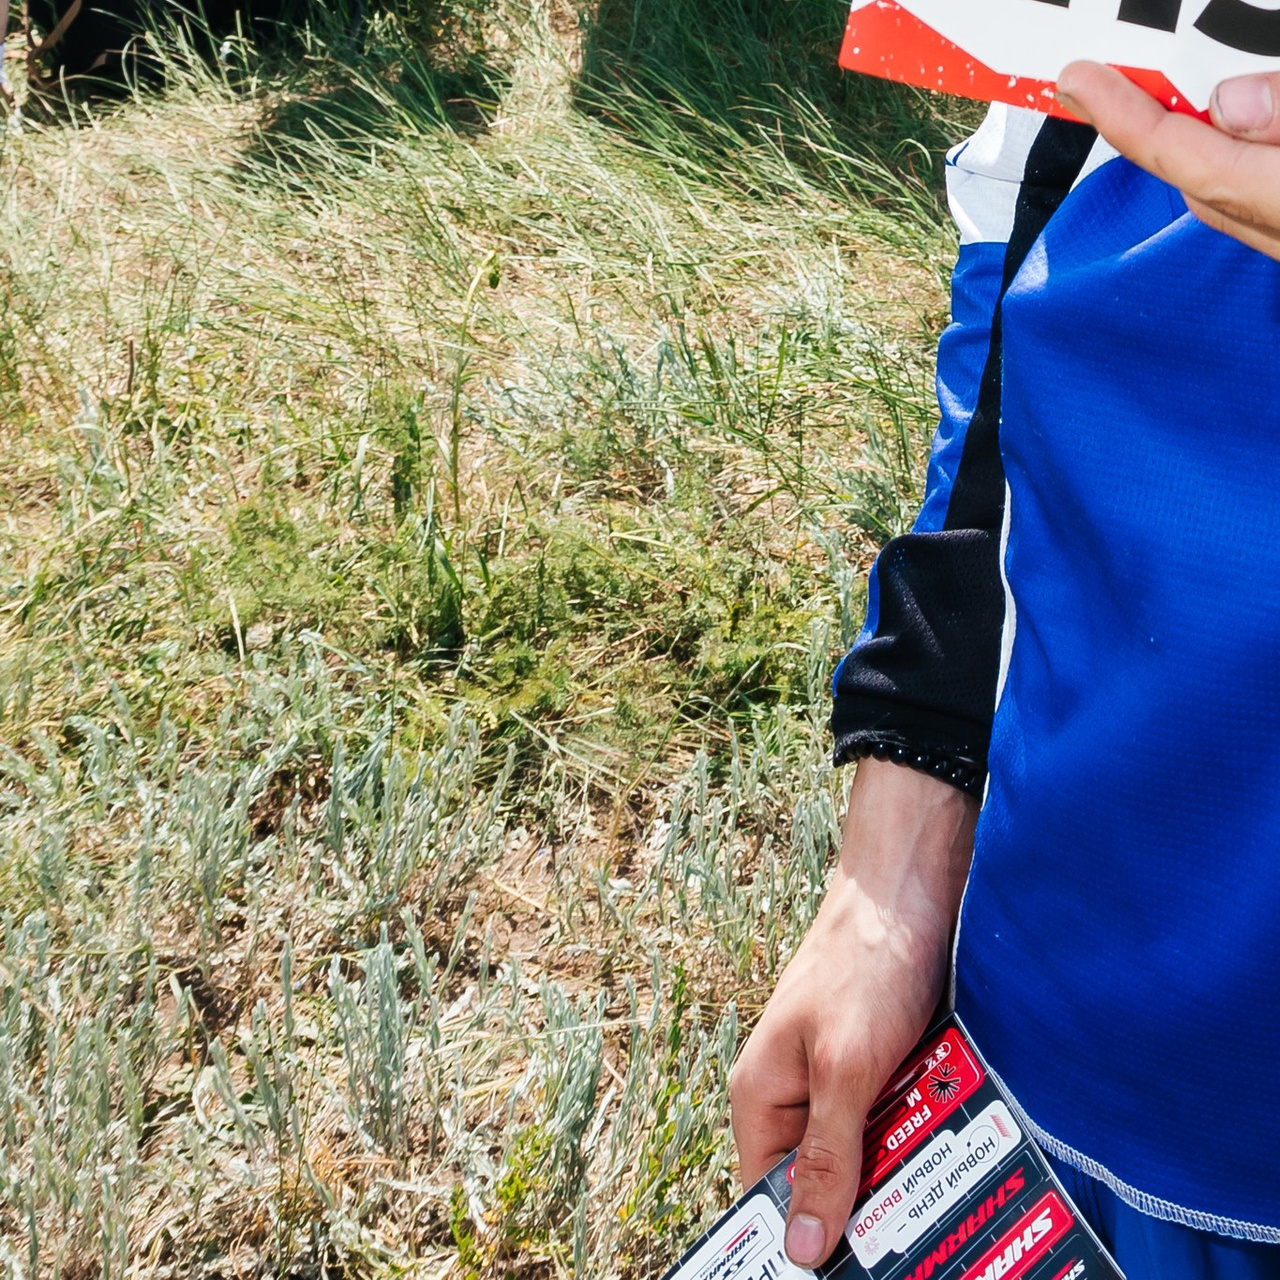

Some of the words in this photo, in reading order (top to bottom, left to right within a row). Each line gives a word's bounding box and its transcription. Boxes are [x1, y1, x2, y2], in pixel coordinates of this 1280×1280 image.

[902, 1142, 953, 1195] НОВЫЙ
[945, 1136, 996, 1190] НОВЫЙ
[854, 1188, 904, 1238] ВЫЗОВ
[908, 1181, 945, 1220] ДЕНЬ
